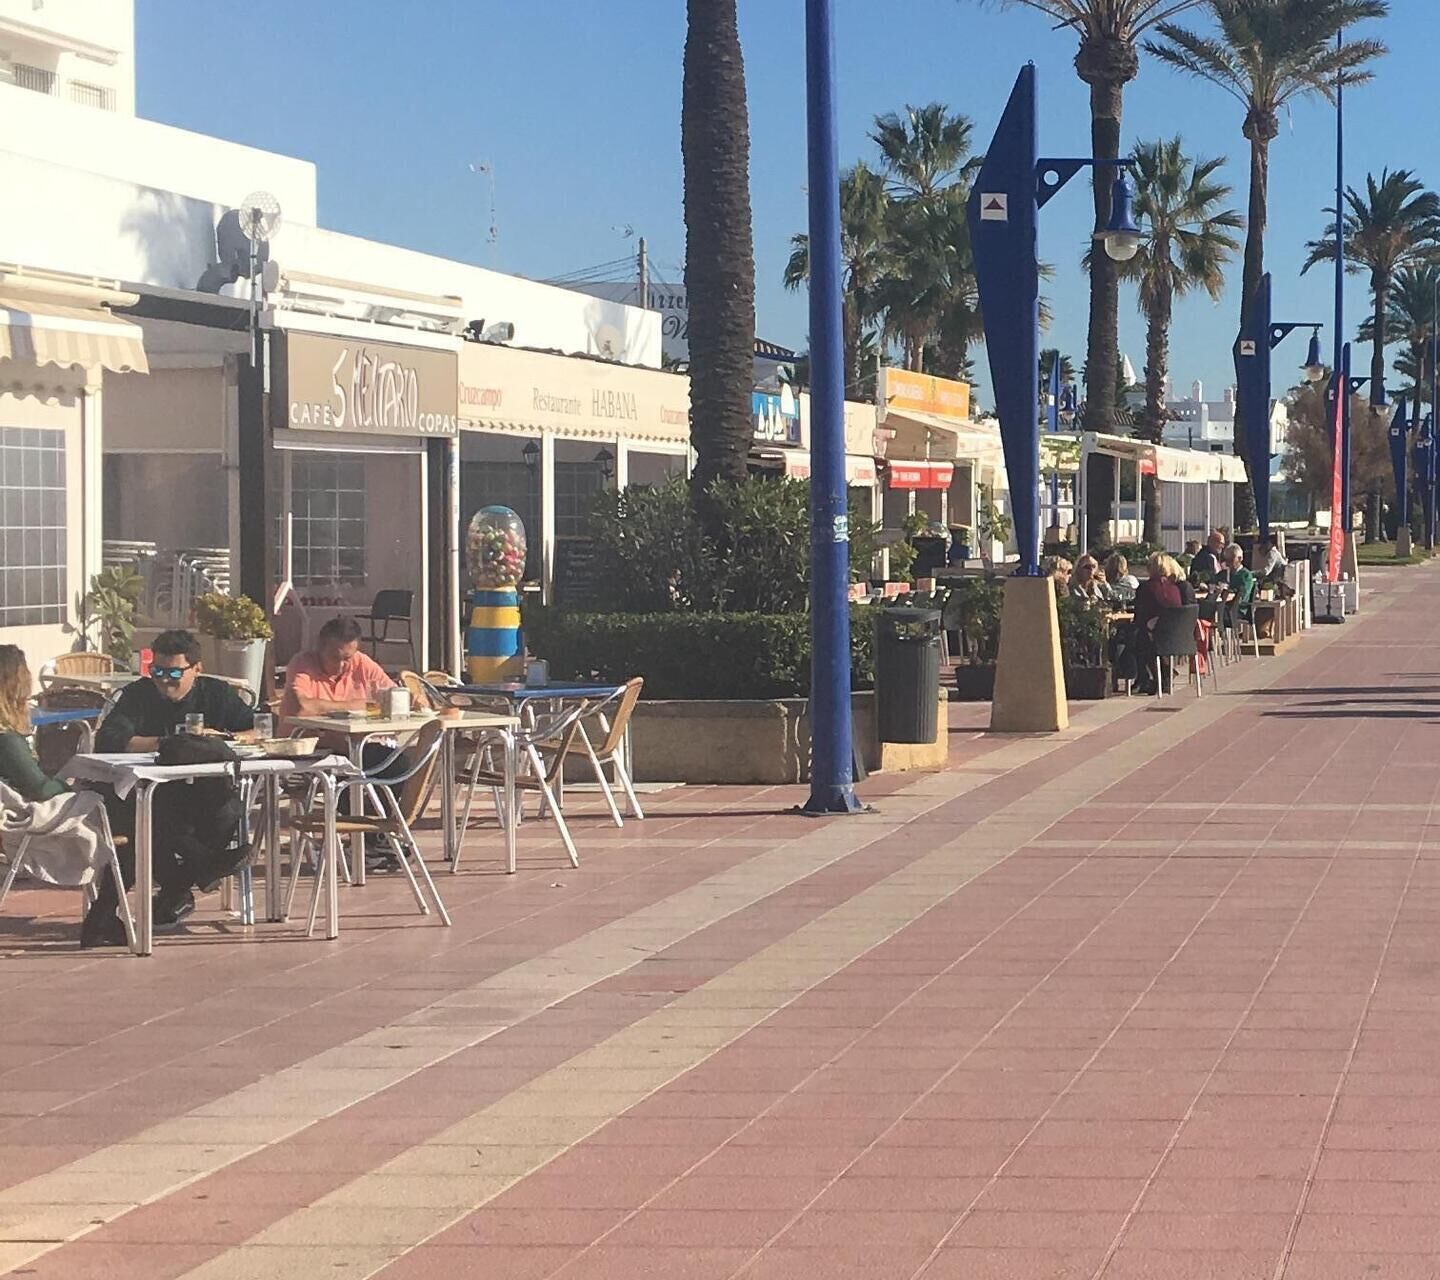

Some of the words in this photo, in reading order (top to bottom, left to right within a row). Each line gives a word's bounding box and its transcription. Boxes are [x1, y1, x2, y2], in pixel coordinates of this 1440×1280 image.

[532, 387, 582, 417] Restaurante
[592, 388, 638, 421] HABANA
[418, 412, 457, 434] COPAS
